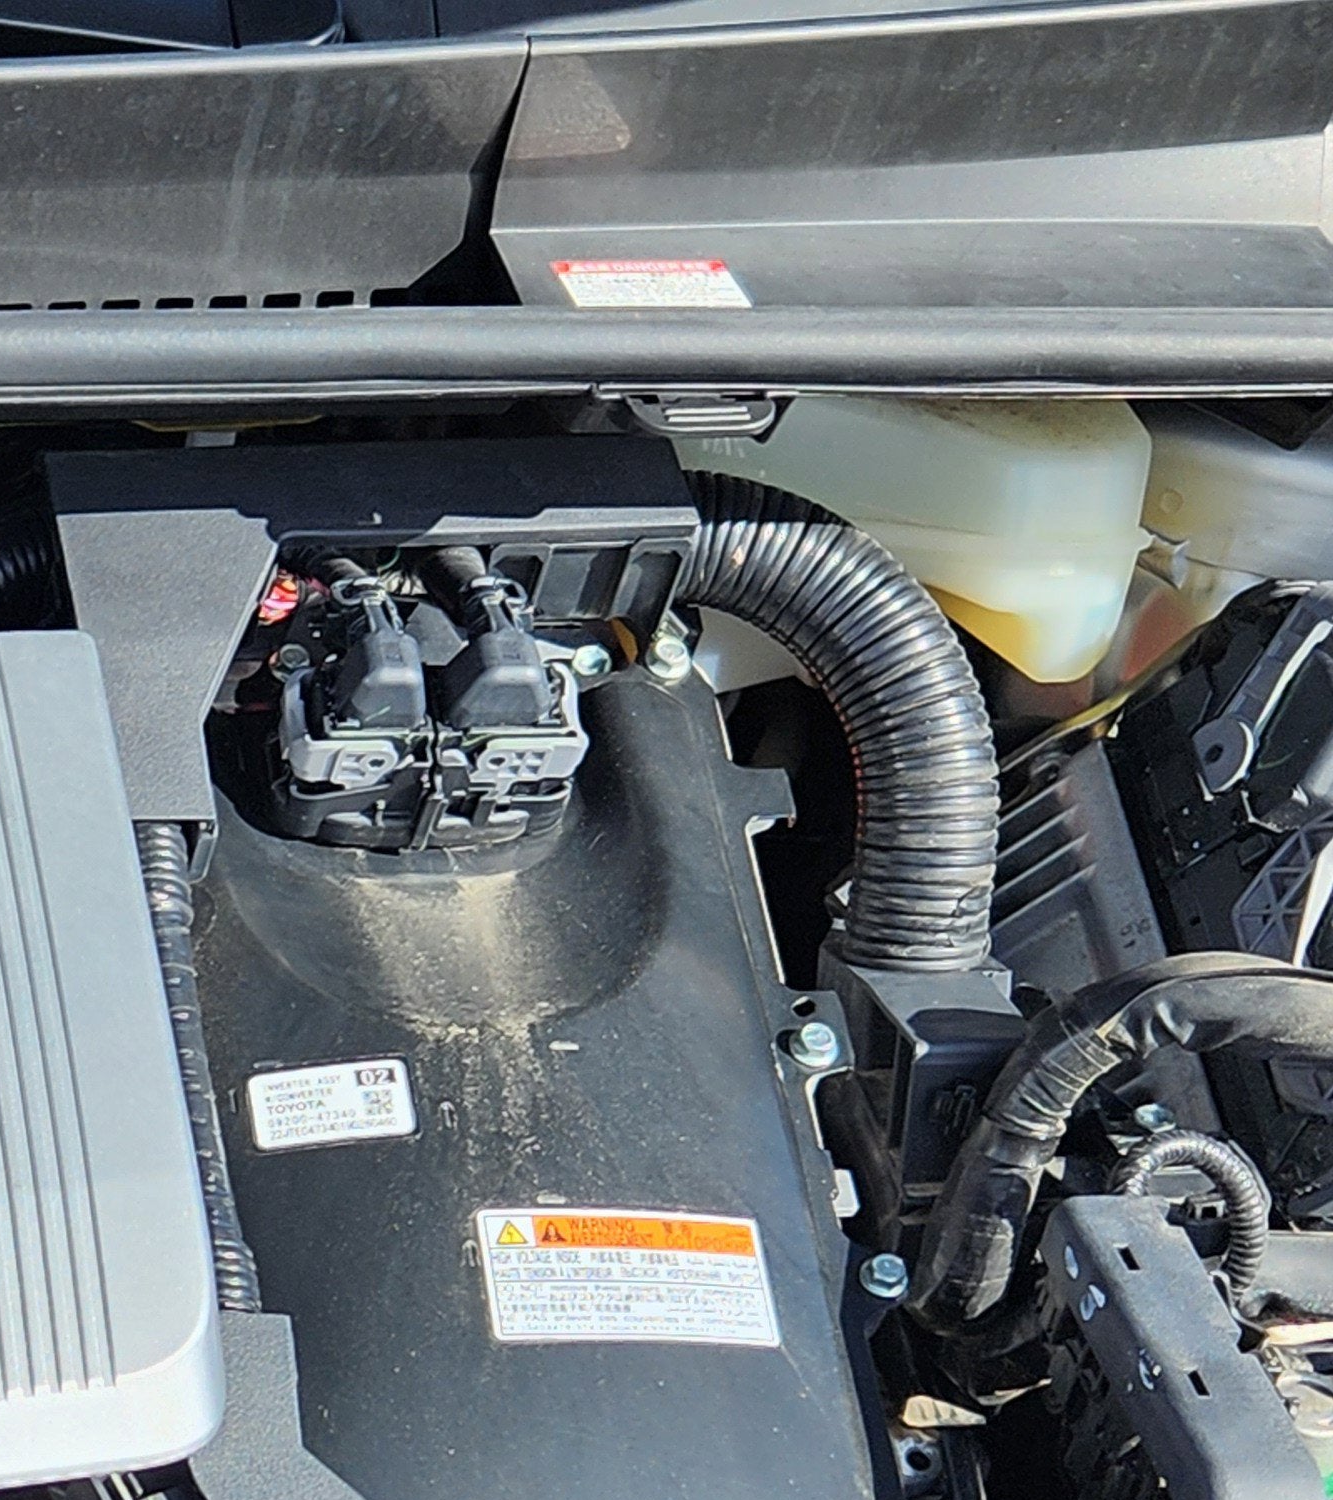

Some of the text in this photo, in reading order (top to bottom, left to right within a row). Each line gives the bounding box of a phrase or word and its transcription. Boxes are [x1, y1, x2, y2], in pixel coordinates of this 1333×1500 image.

[359, 1069, 390, 1086] 02
[267, 1101, 326, 1115] TOYOTA
[570, 1218, 634, 1232] WARNING
